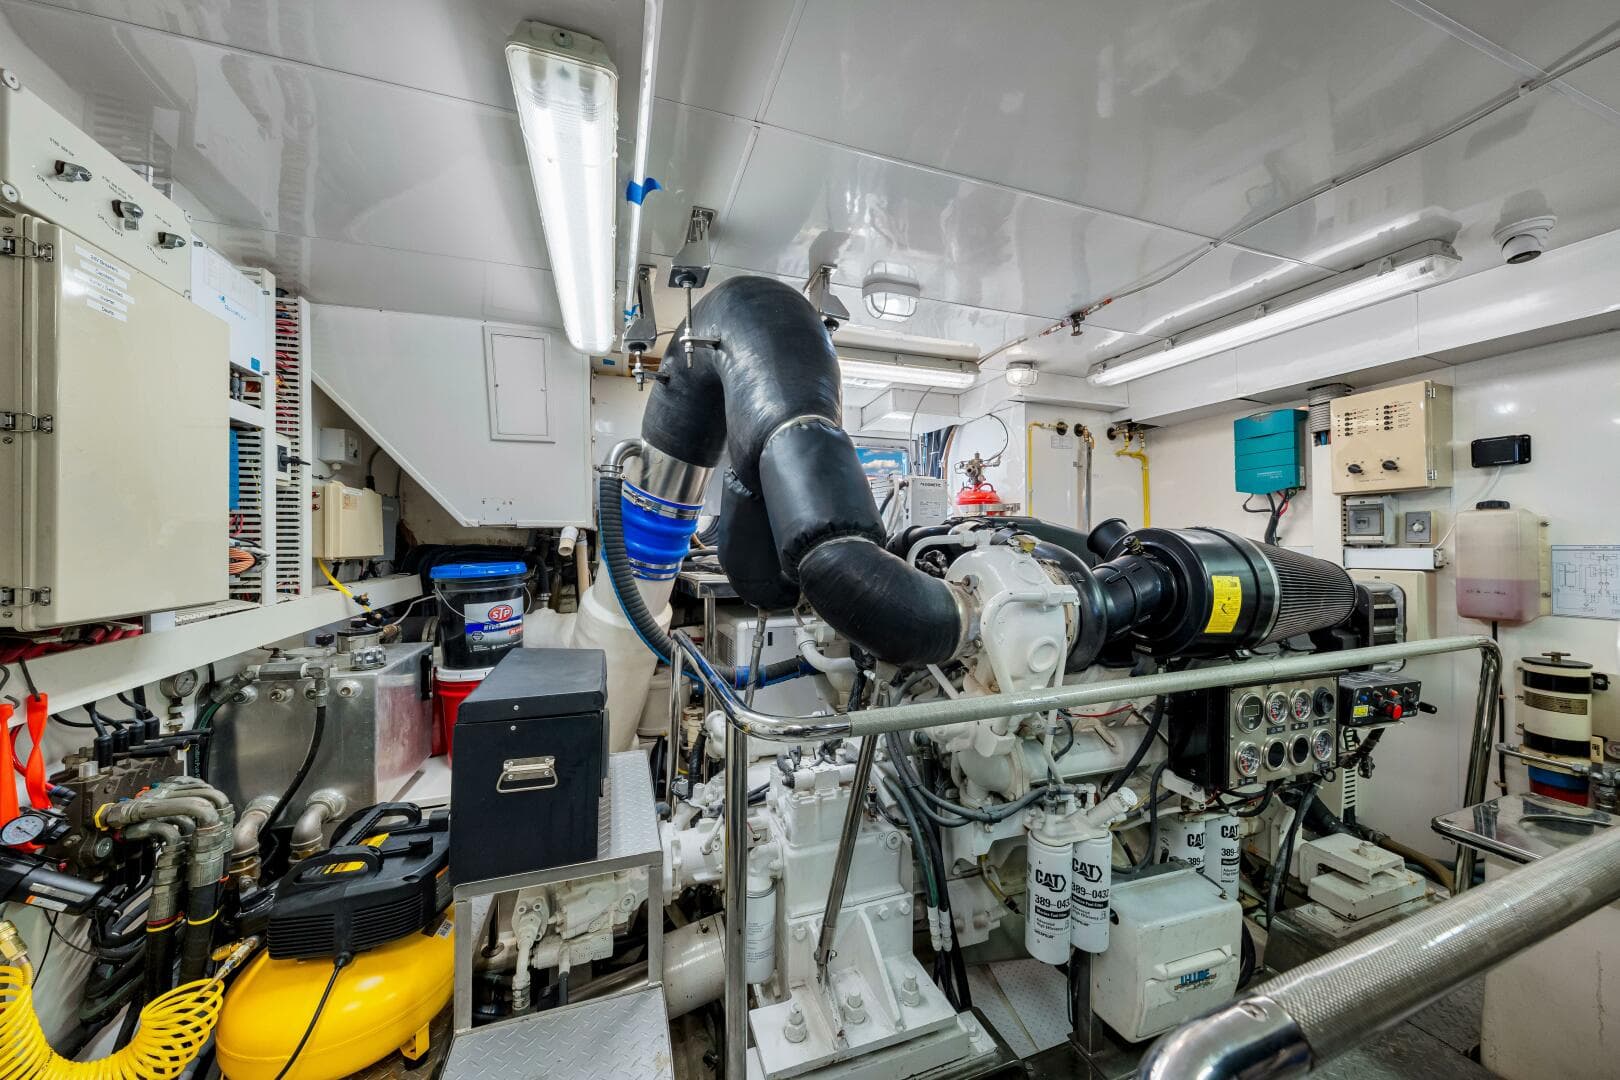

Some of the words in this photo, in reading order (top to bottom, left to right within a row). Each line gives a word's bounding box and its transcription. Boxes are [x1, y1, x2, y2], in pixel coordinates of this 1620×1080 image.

[492, 607, 511, 620] STP
[1221, 824, 1239, 839] CAT
[1072, 858, 1098, 880] CAT
[1035, 869, 1061, 889] CAT
